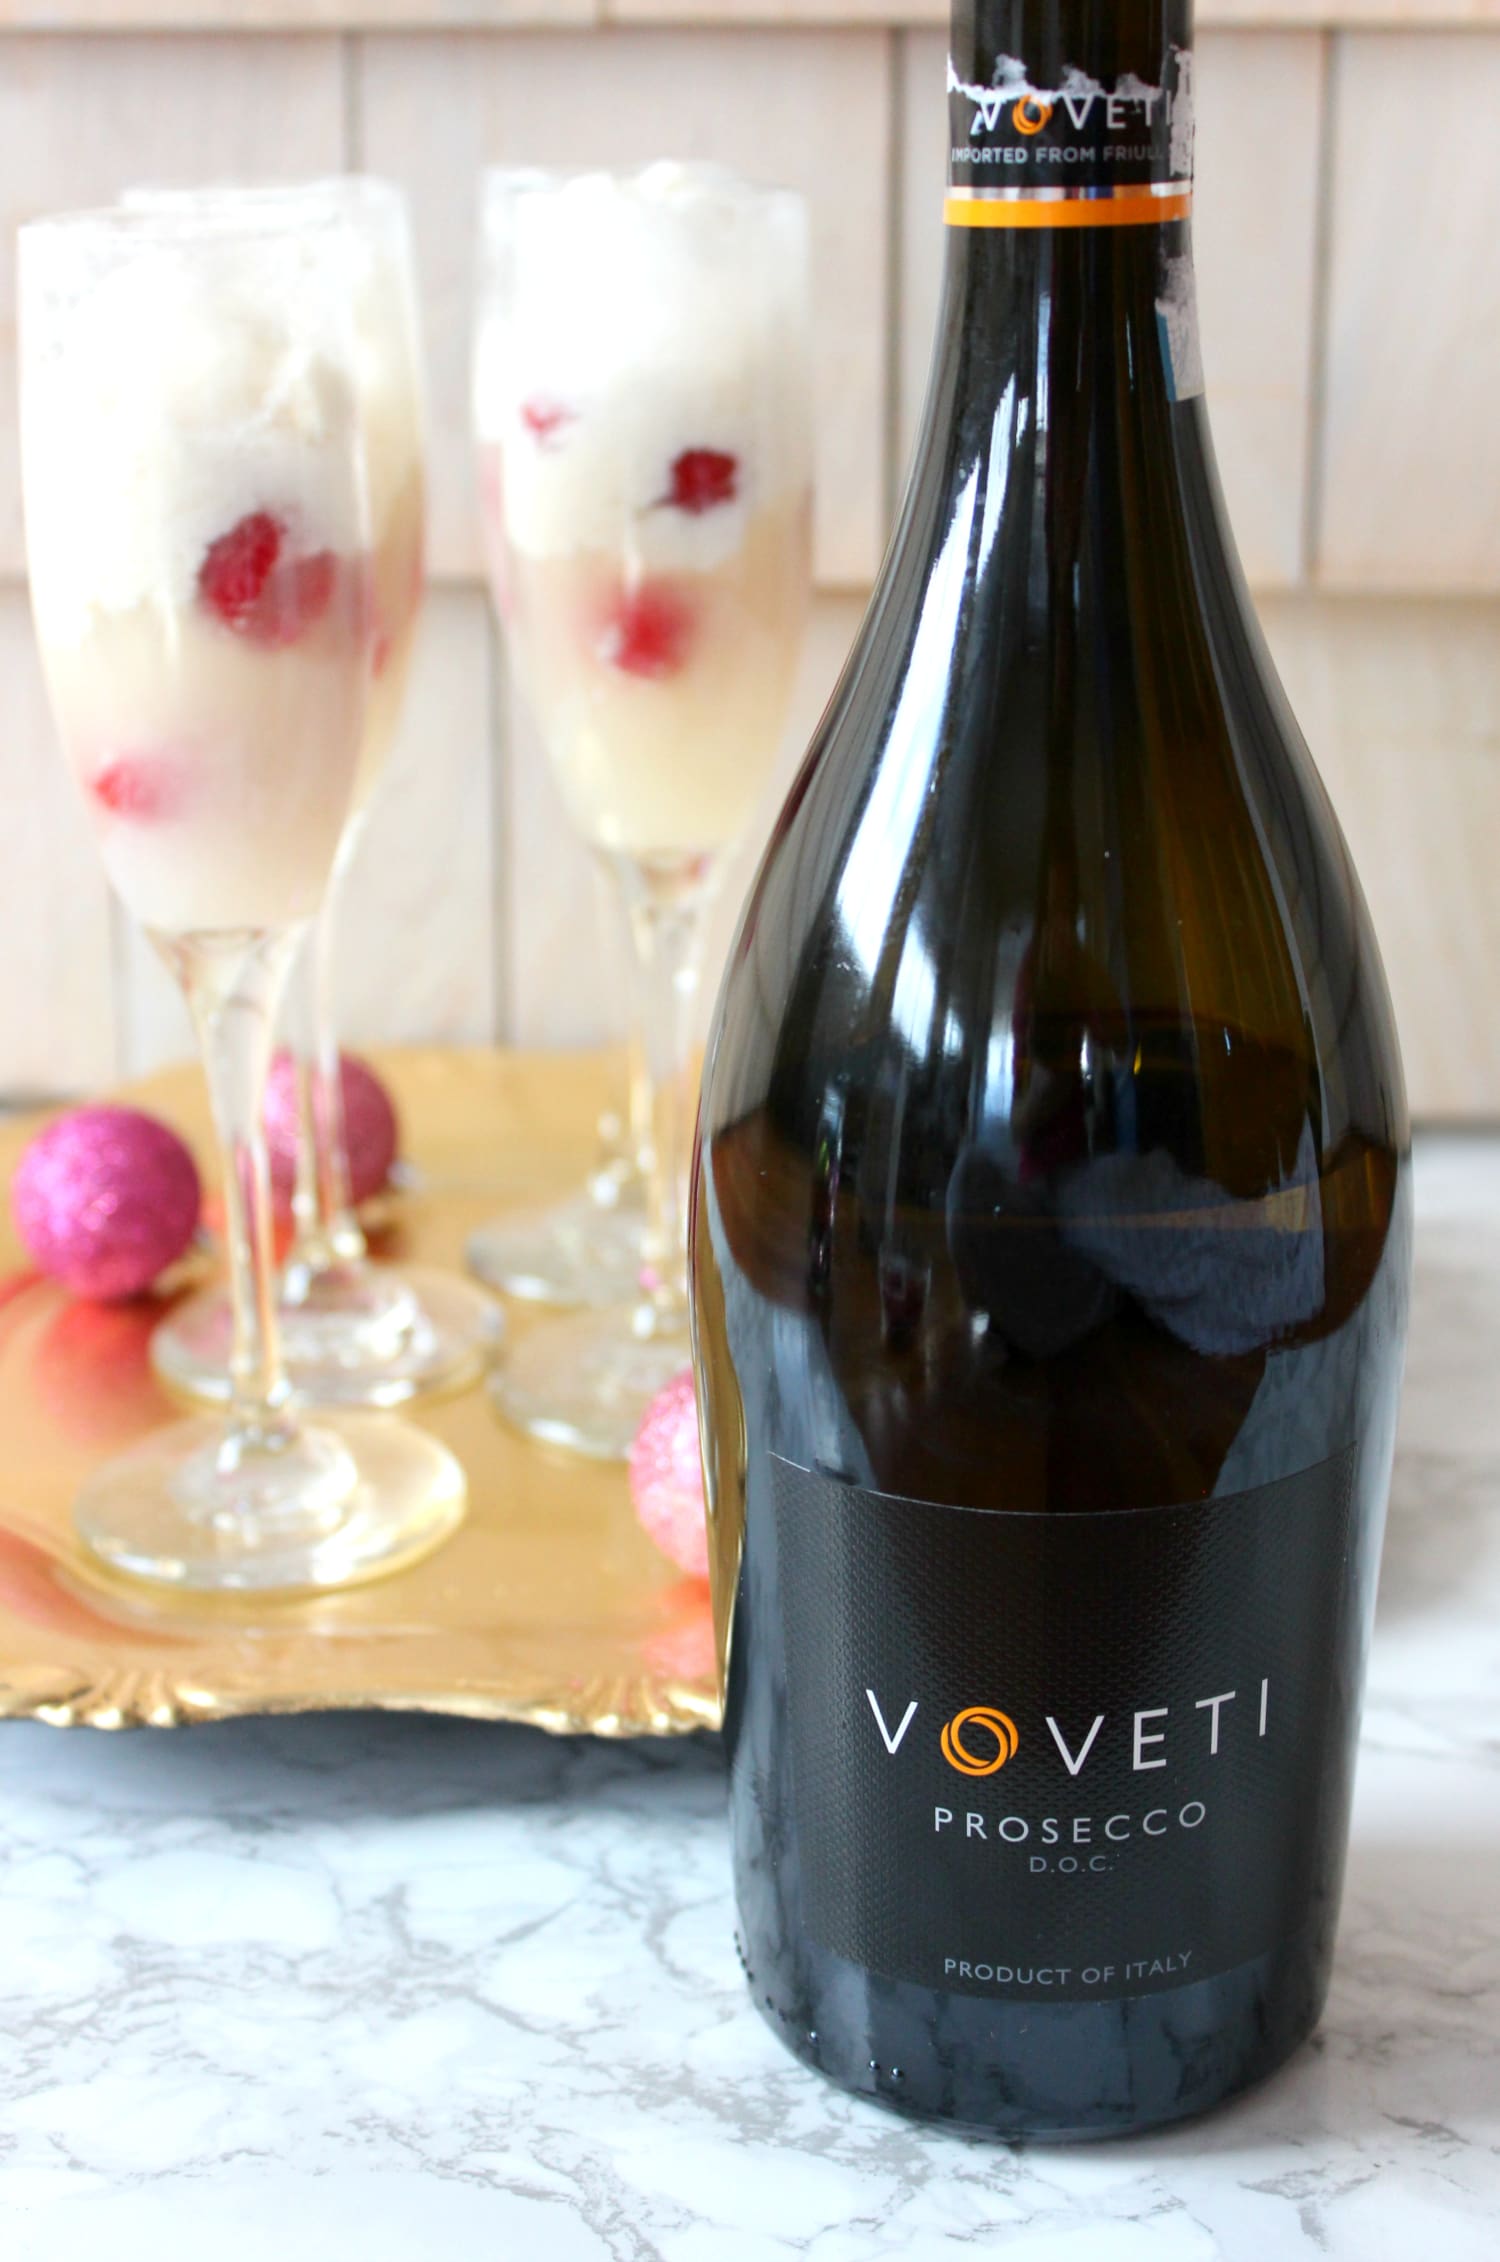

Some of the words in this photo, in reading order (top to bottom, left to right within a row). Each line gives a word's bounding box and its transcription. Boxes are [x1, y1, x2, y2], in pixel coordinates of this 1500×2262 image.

[979, 90, 1172, 136] VOVETI
[951, 146, 1029, 164] IMPORTED
[1035, 146, 1096, 164] FROM
[865, 1677, 1269, 1777] VOVETI
[934, 1801, 1207, 1844] PROSECCO
[1029, 1856, 1114, 1873] D.O.C.
[944, 1959, 1071, 1986] PRODUCT
[1081, 1966, 1116, 1983] OF
[1125, 1950, 1193, 1980] ITALY
